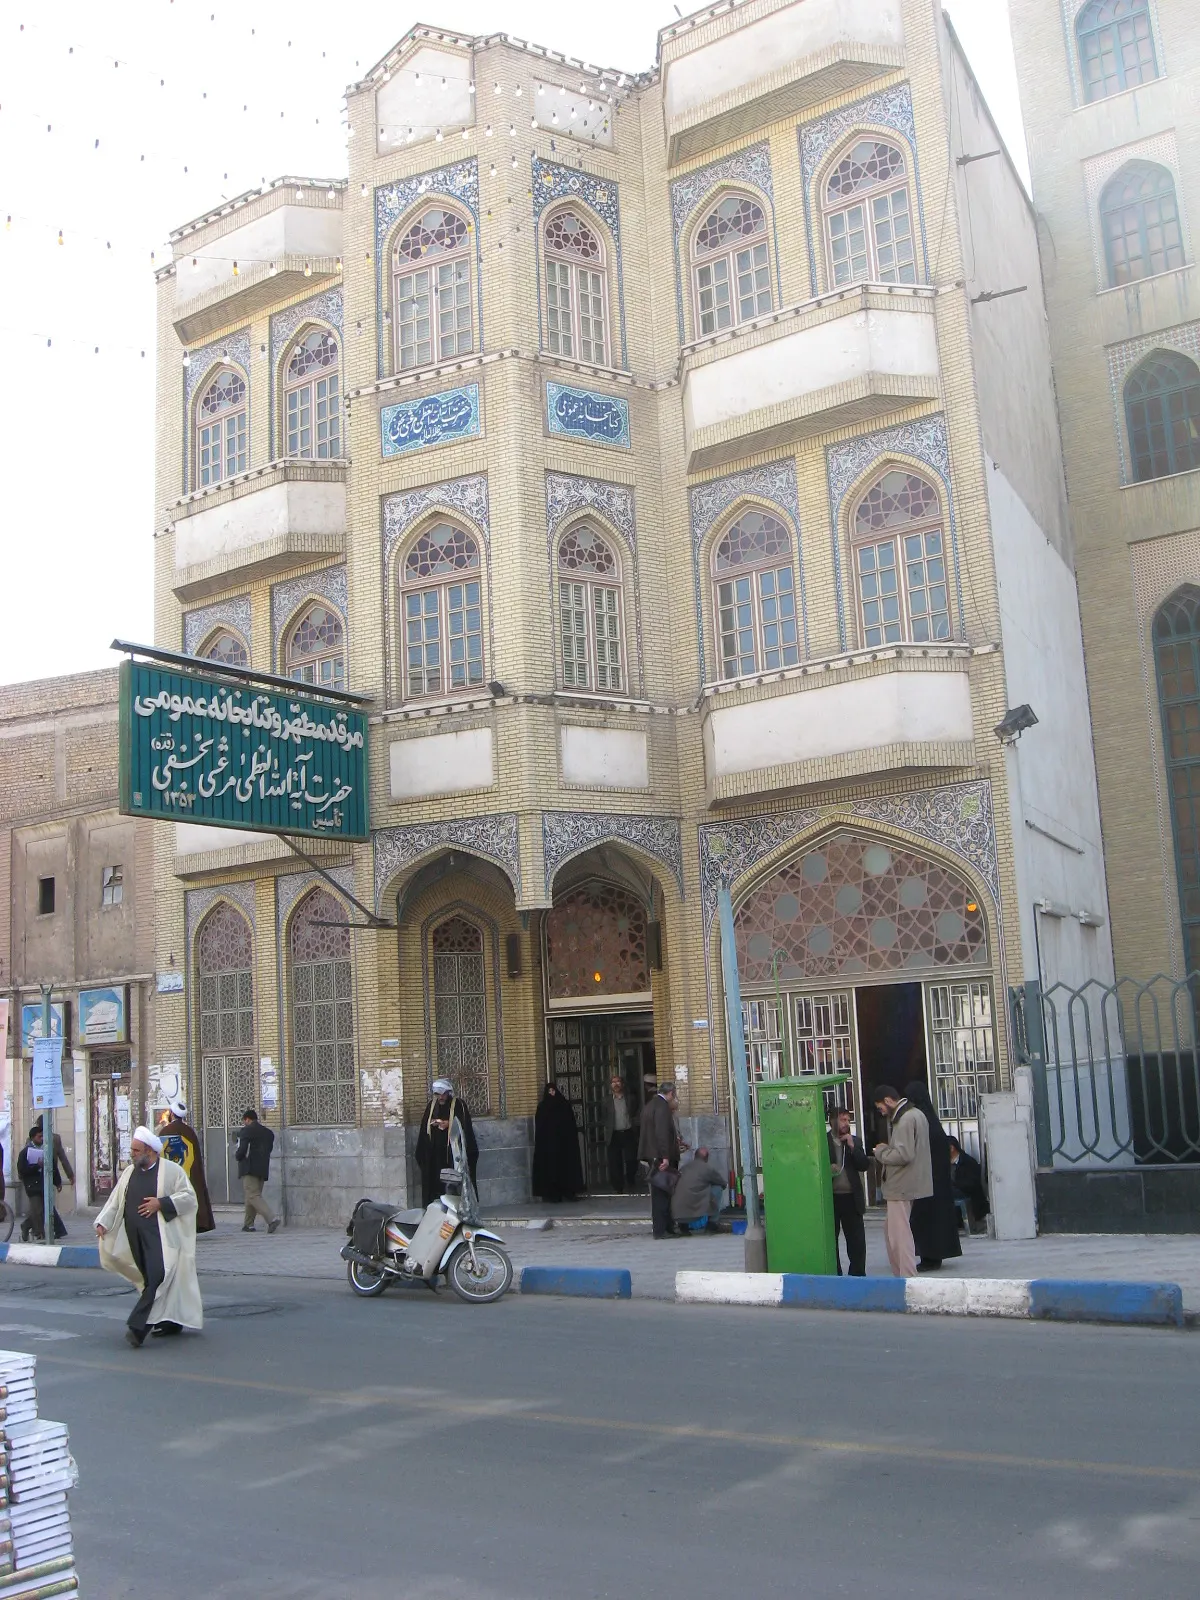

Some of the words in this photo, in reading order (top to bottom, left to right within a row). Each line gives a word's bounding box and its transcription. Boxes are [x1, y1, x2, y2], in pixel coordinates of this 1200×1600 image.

[134, 690, 208, 722] عمومی
[207, 687, 275, 738] کتابخانه
[270, 713, 282, 738] و
[326, 712, 364, 751] مرقد
[152, 733, 214, 791] نجفی
[198, 736, 237, 798] مرعشی
[305, 775, 353, 812] حضرت
